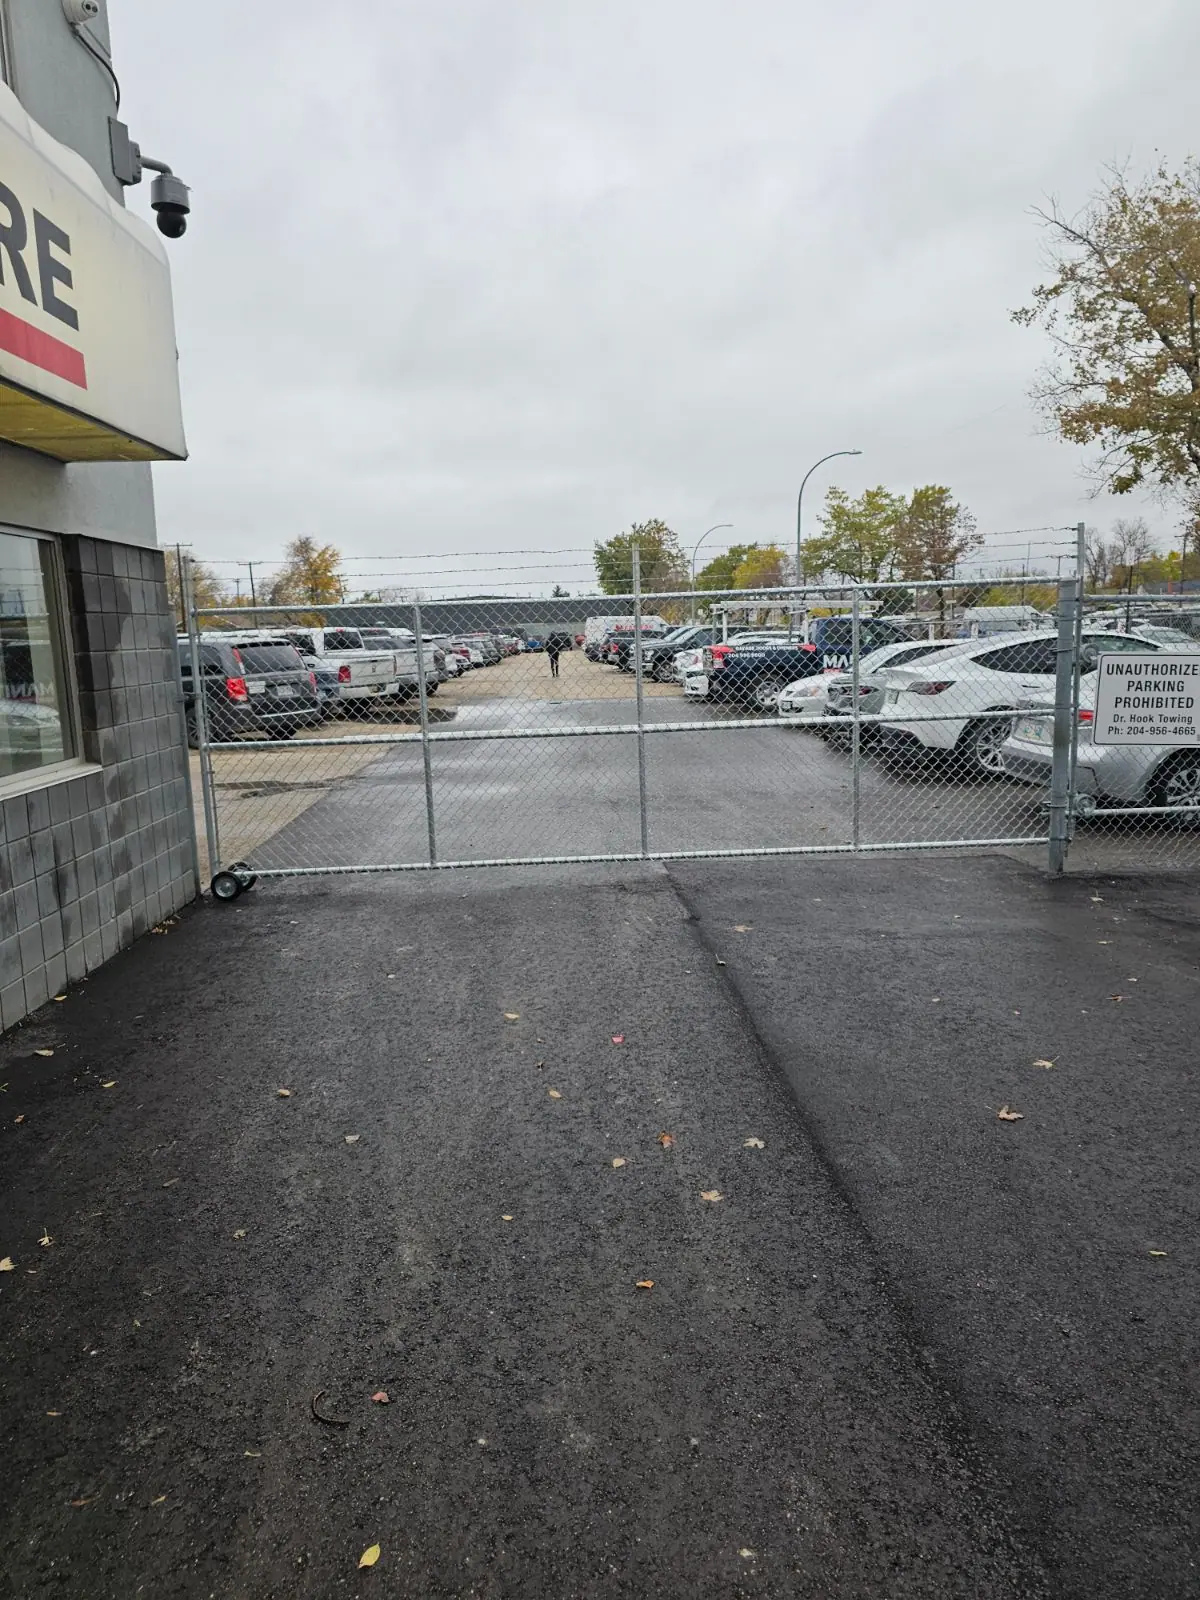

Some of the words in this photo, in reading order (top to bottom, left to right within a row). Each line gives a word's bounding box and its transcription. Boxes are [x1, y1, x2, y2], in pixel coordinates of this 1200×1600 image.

[1106, 663, 1200, 676] UNAUTHORIZE
[1126, 680, 1185, 692] PARKING
[1114, 696, 1194, 709] PROHIBITED
[1113, 714, 1127, 723] Dr.
[1129, 714, 1155, 723] Hook
[1158, 714, 1193, 725] Towing
[1107, 726, 1123, 735] Ph:
[1126, 726, 1196, 736] 204-956-4665
